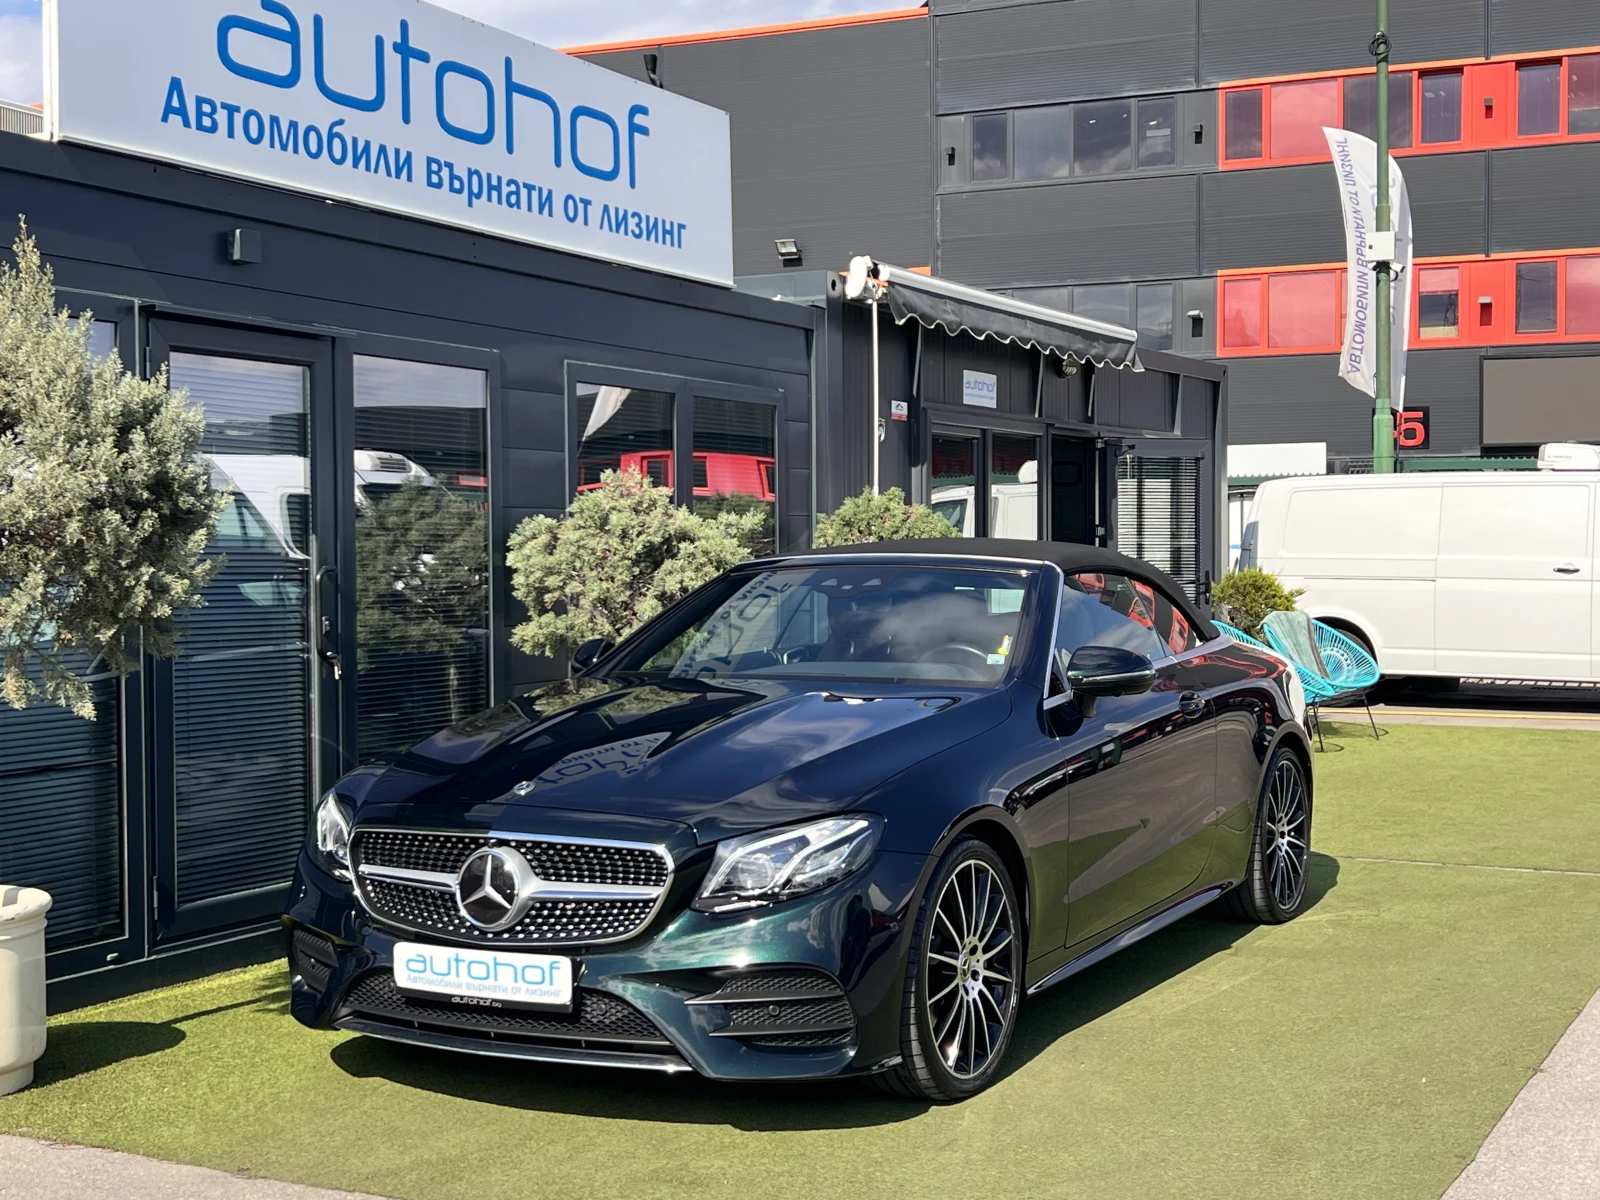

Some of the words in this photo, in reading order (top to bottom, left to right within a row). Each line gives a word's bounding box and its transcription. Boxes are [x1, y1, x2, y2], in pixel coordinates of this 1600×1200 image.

[217, 0, 650, 189] autohof
[160, 76, 413, 183] Автомобили
[426, 155, 553, 217] върнати
[563, 193, 592, 226] от
[599, 203, 687, 249] лизинг
[405, 953, 561, 986] autohof
[406, 974, 463, 990] Автомобили
[465, 981, 508, 996] върнати
[511, 985, 522, 995] от
[525, 987, 562, 998] лизинг
